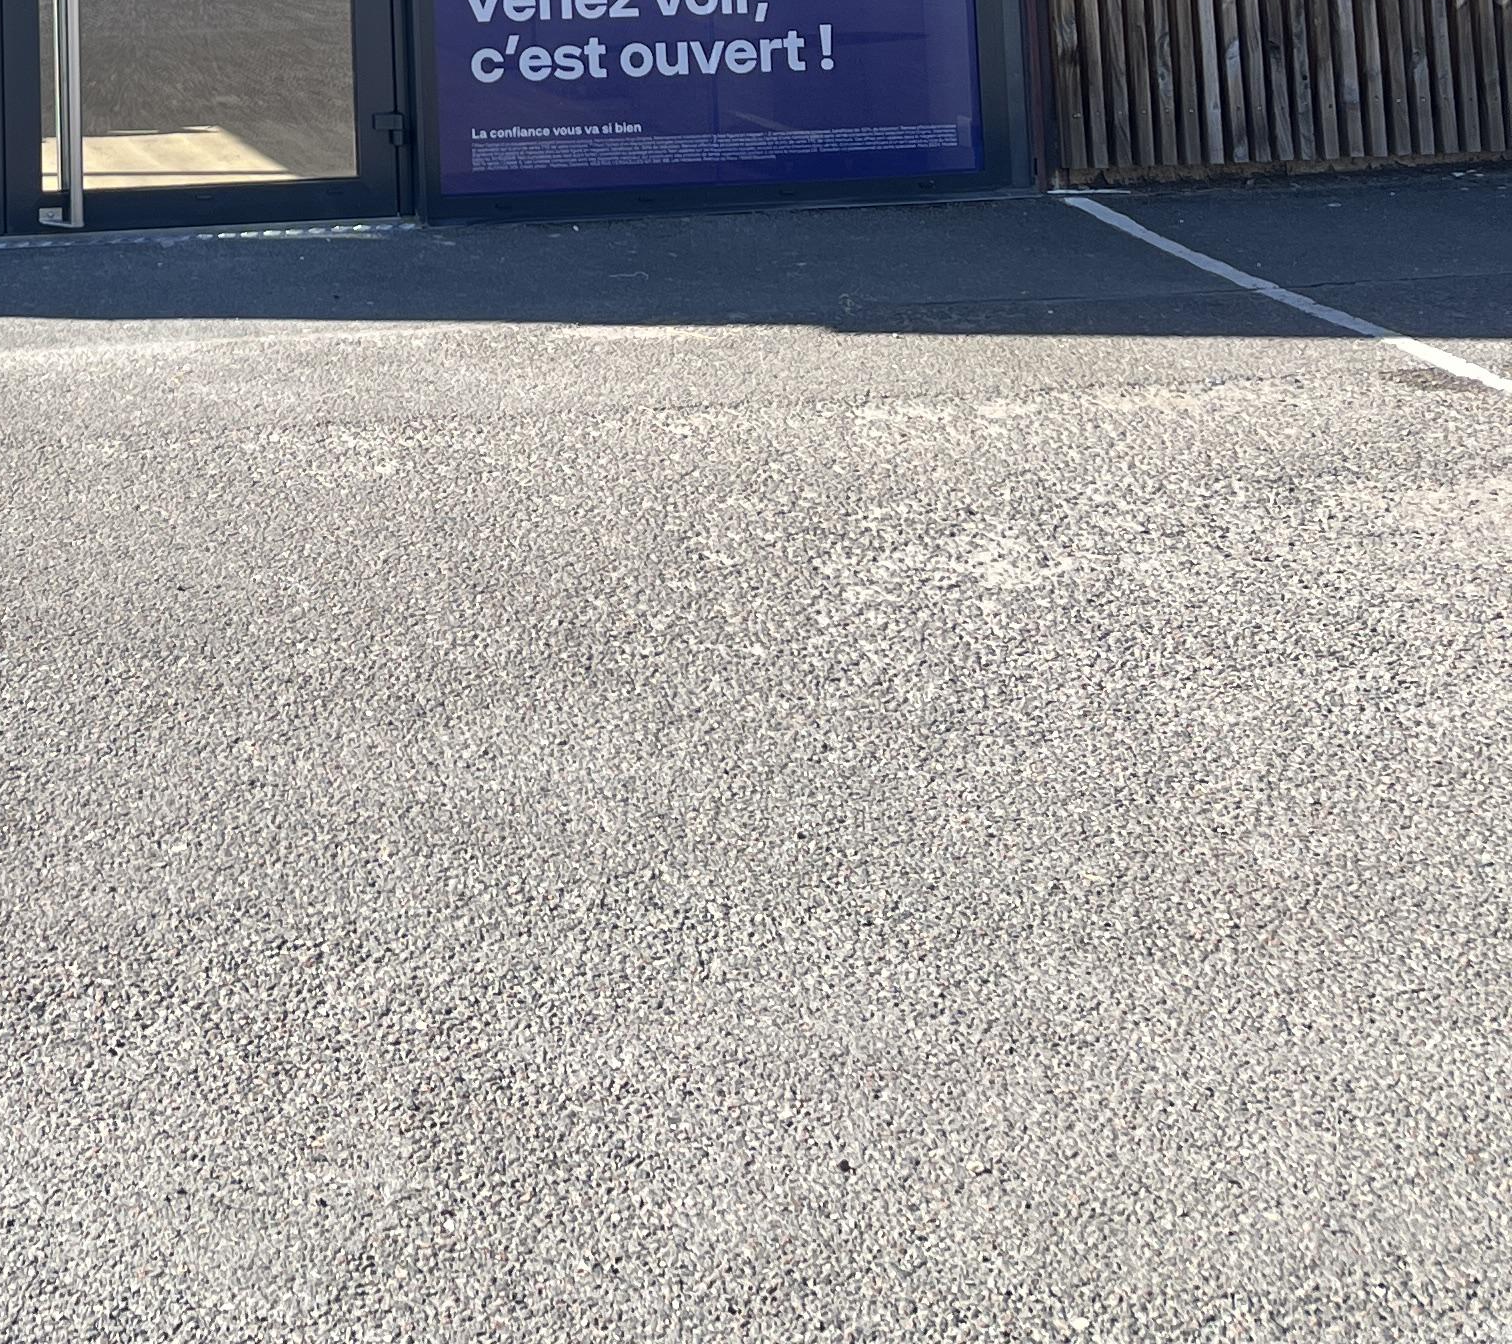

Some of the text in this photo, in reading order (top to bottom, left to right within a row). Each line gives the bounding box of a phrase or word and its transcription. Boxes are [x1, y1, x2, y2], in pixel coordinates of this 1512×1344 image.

[470, 24, 835, 83] c’est ouvert !
[471, 121, 642, 140] La confiance vous va si bien
